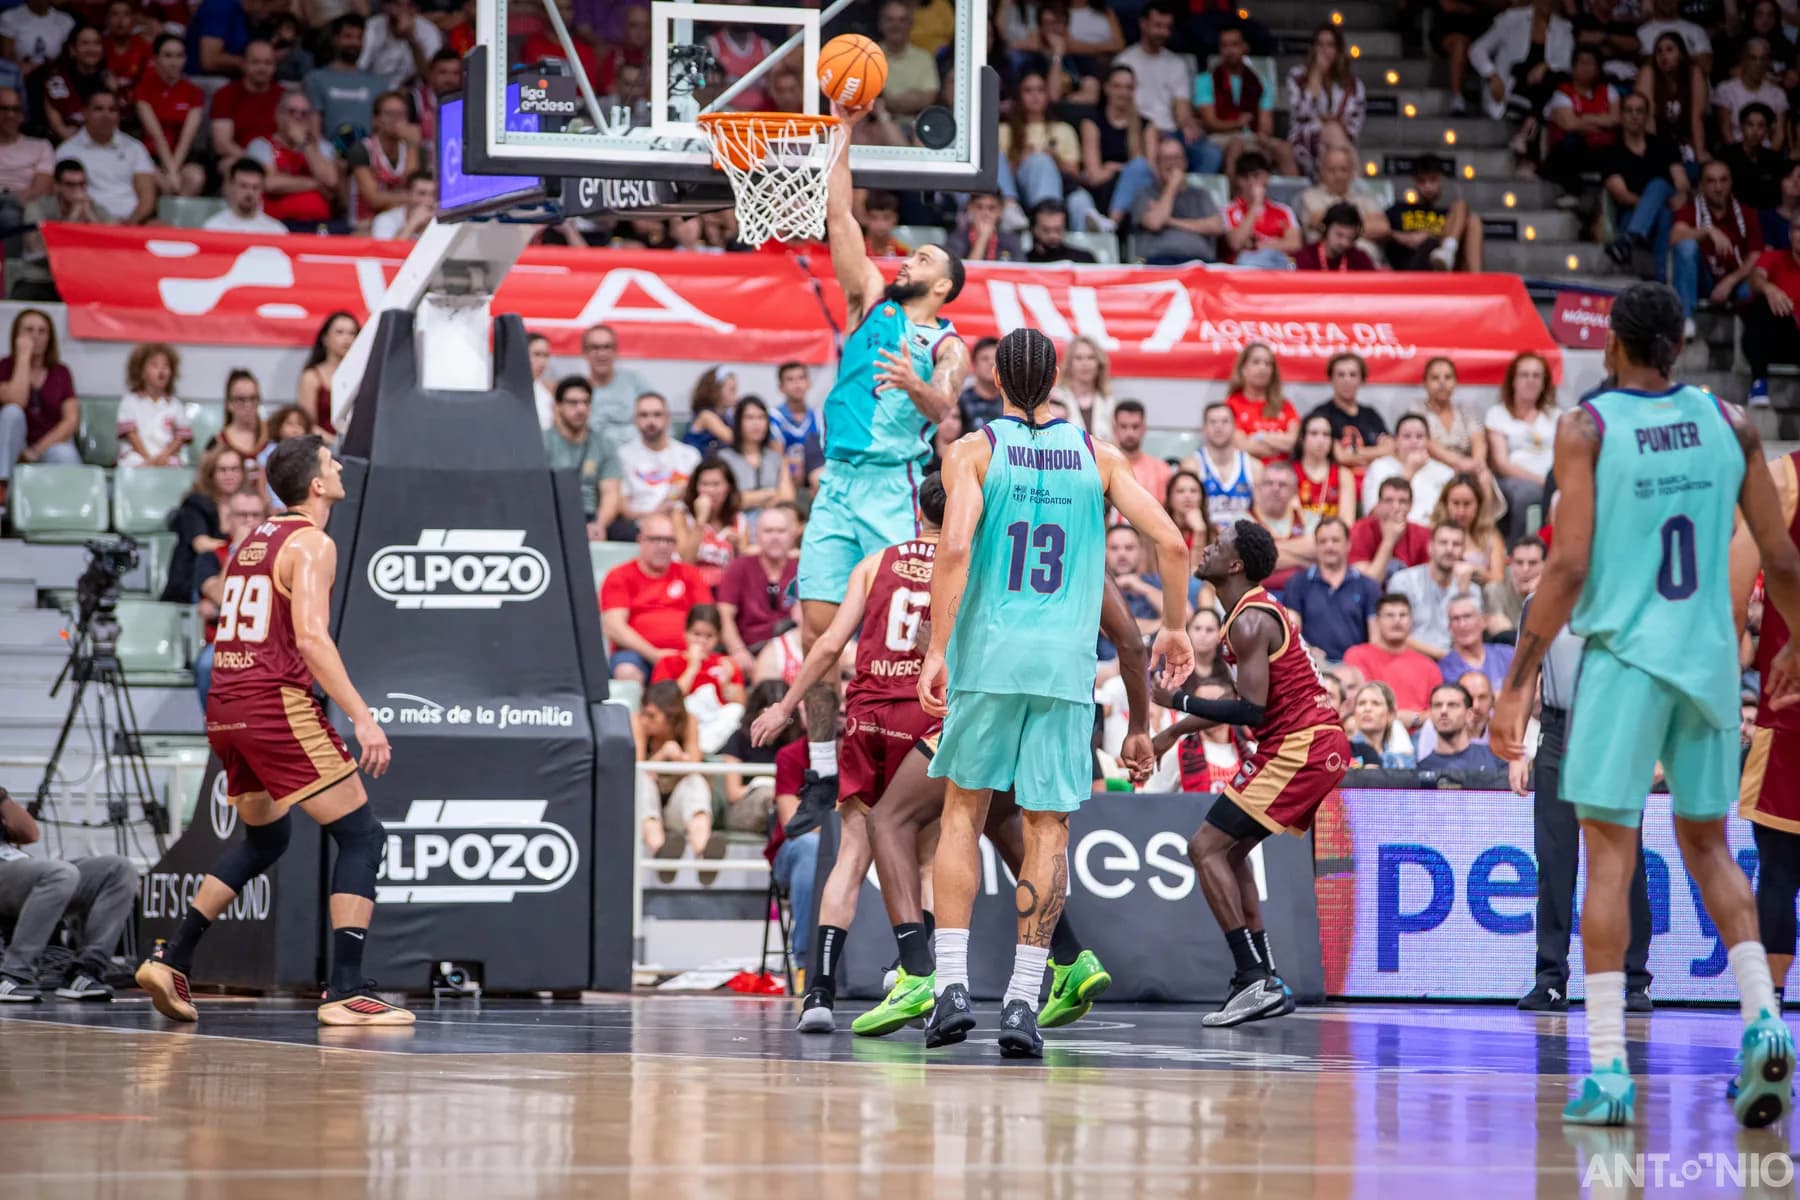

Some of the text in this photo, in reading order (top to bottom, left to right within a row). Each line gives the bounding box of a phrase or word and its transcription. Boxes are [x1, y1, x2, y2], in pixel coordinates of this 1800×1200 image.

[521, 85, 546, 100] liga
[521, 99, 575, 112] endesa
[1352, 322, 1399, 346] DE
[1634, 421, 1702, 455] PUNTER
[1030, 496, 1072, 505] FOUNDATION
[898, 543, 936, 558] MARC
[1007, 520, 1067, 595] 13
[1656, 513, 1699, 601] 0
[213, 574, 273, 643] 99
[885, 586, 931, 652] 6
[871, 659, 921, 677] INVERS
[400, 704, 442, 724] más
[446, 706, 472, 724] de
[476, 706, 495, 725] la
[498, 704, 573, 729] familia
[376, 832, 570, 881] LPOZO
[143, 873, 179, 918] LET'S
